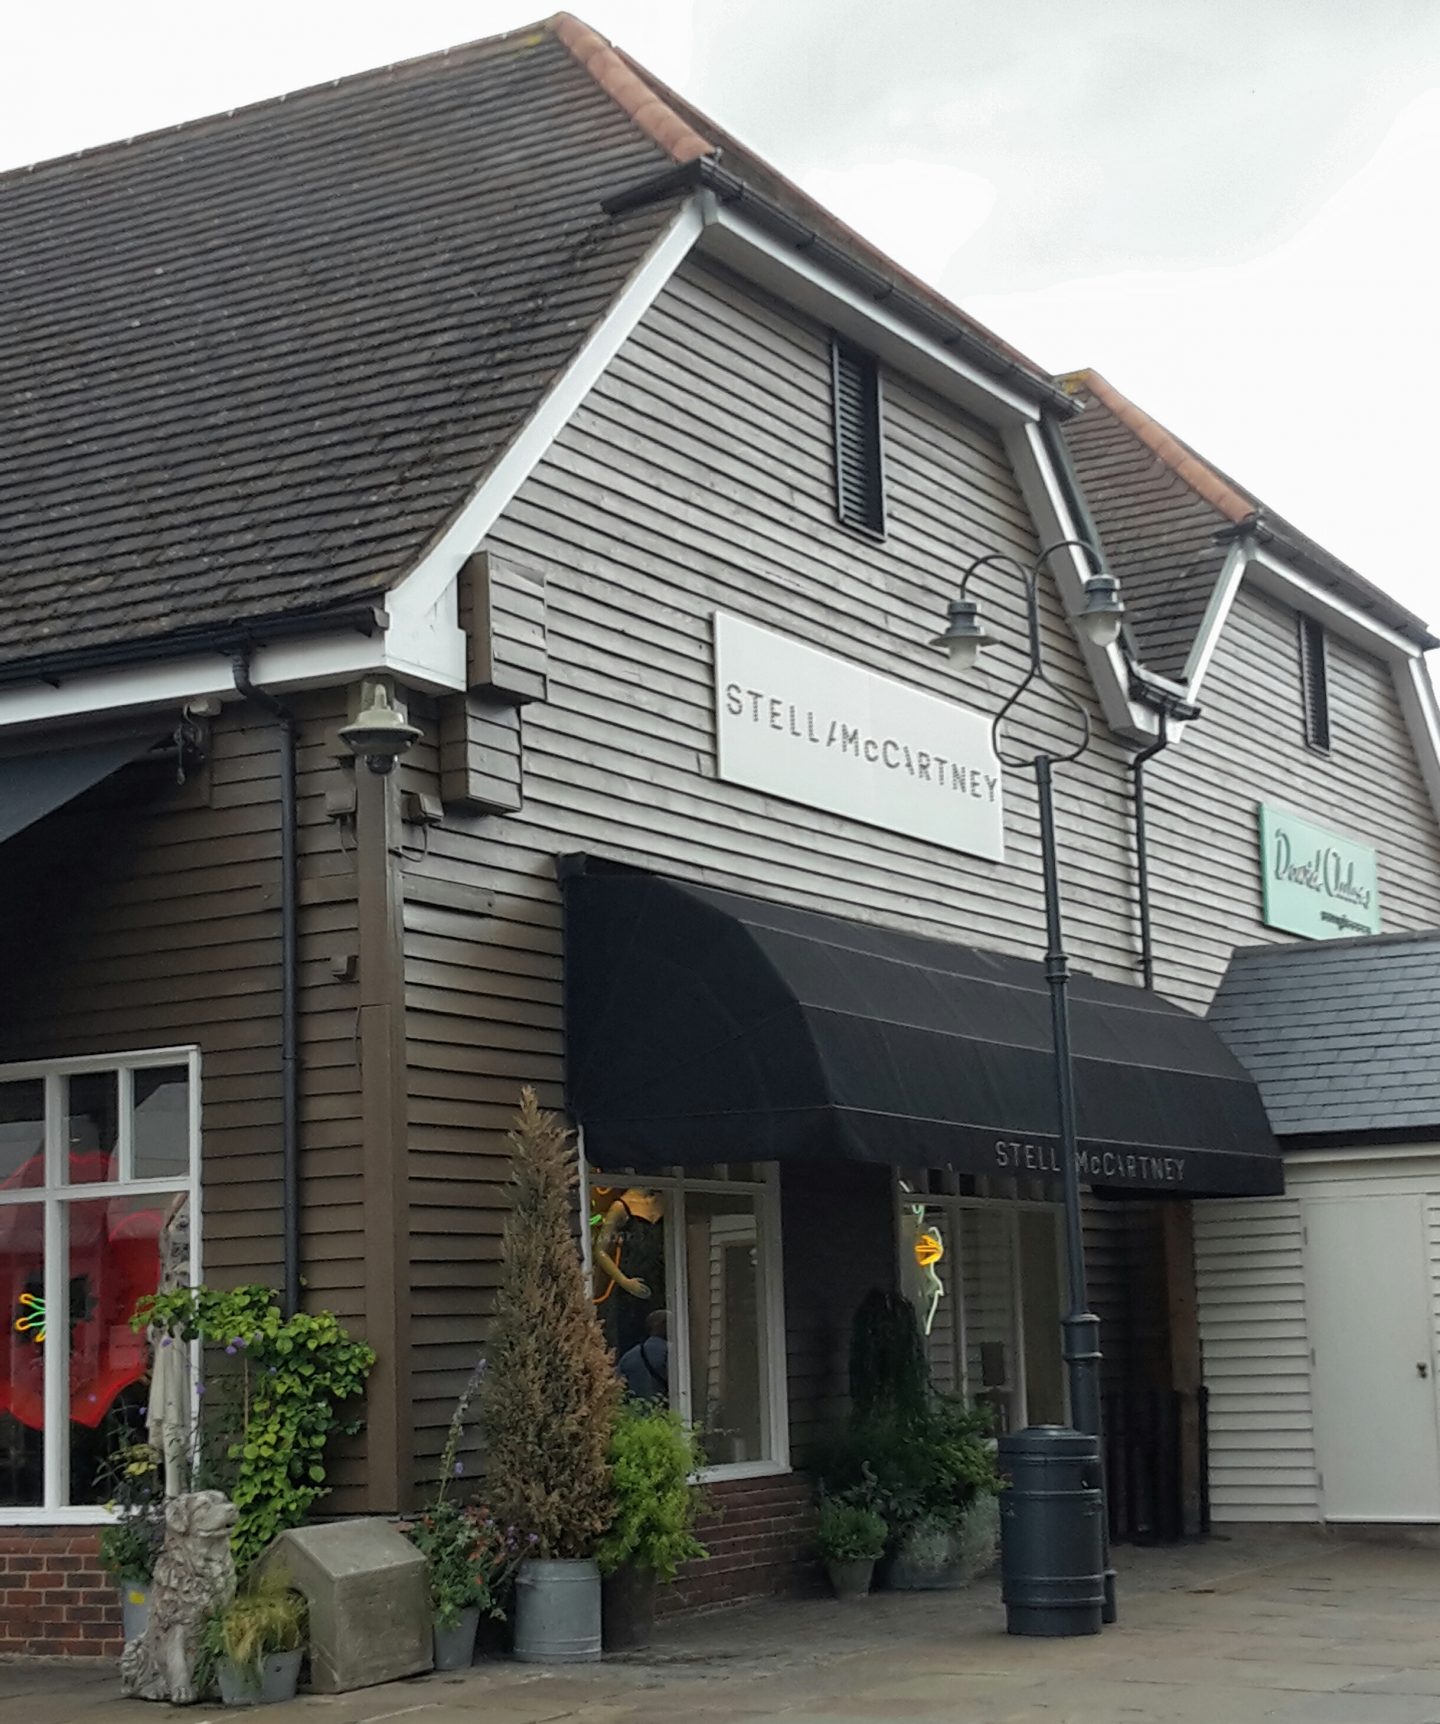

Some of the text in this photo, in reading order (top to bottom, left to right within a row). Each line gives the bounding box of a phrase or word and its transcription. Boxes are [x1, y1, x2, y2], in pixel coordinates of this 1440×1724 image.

[726, 683, 996, 802] STELLA McCARTNEY
[1274, 828, 1322, 892] David
[994, 1140, 1186, 1182] STELL McCARTNEY
